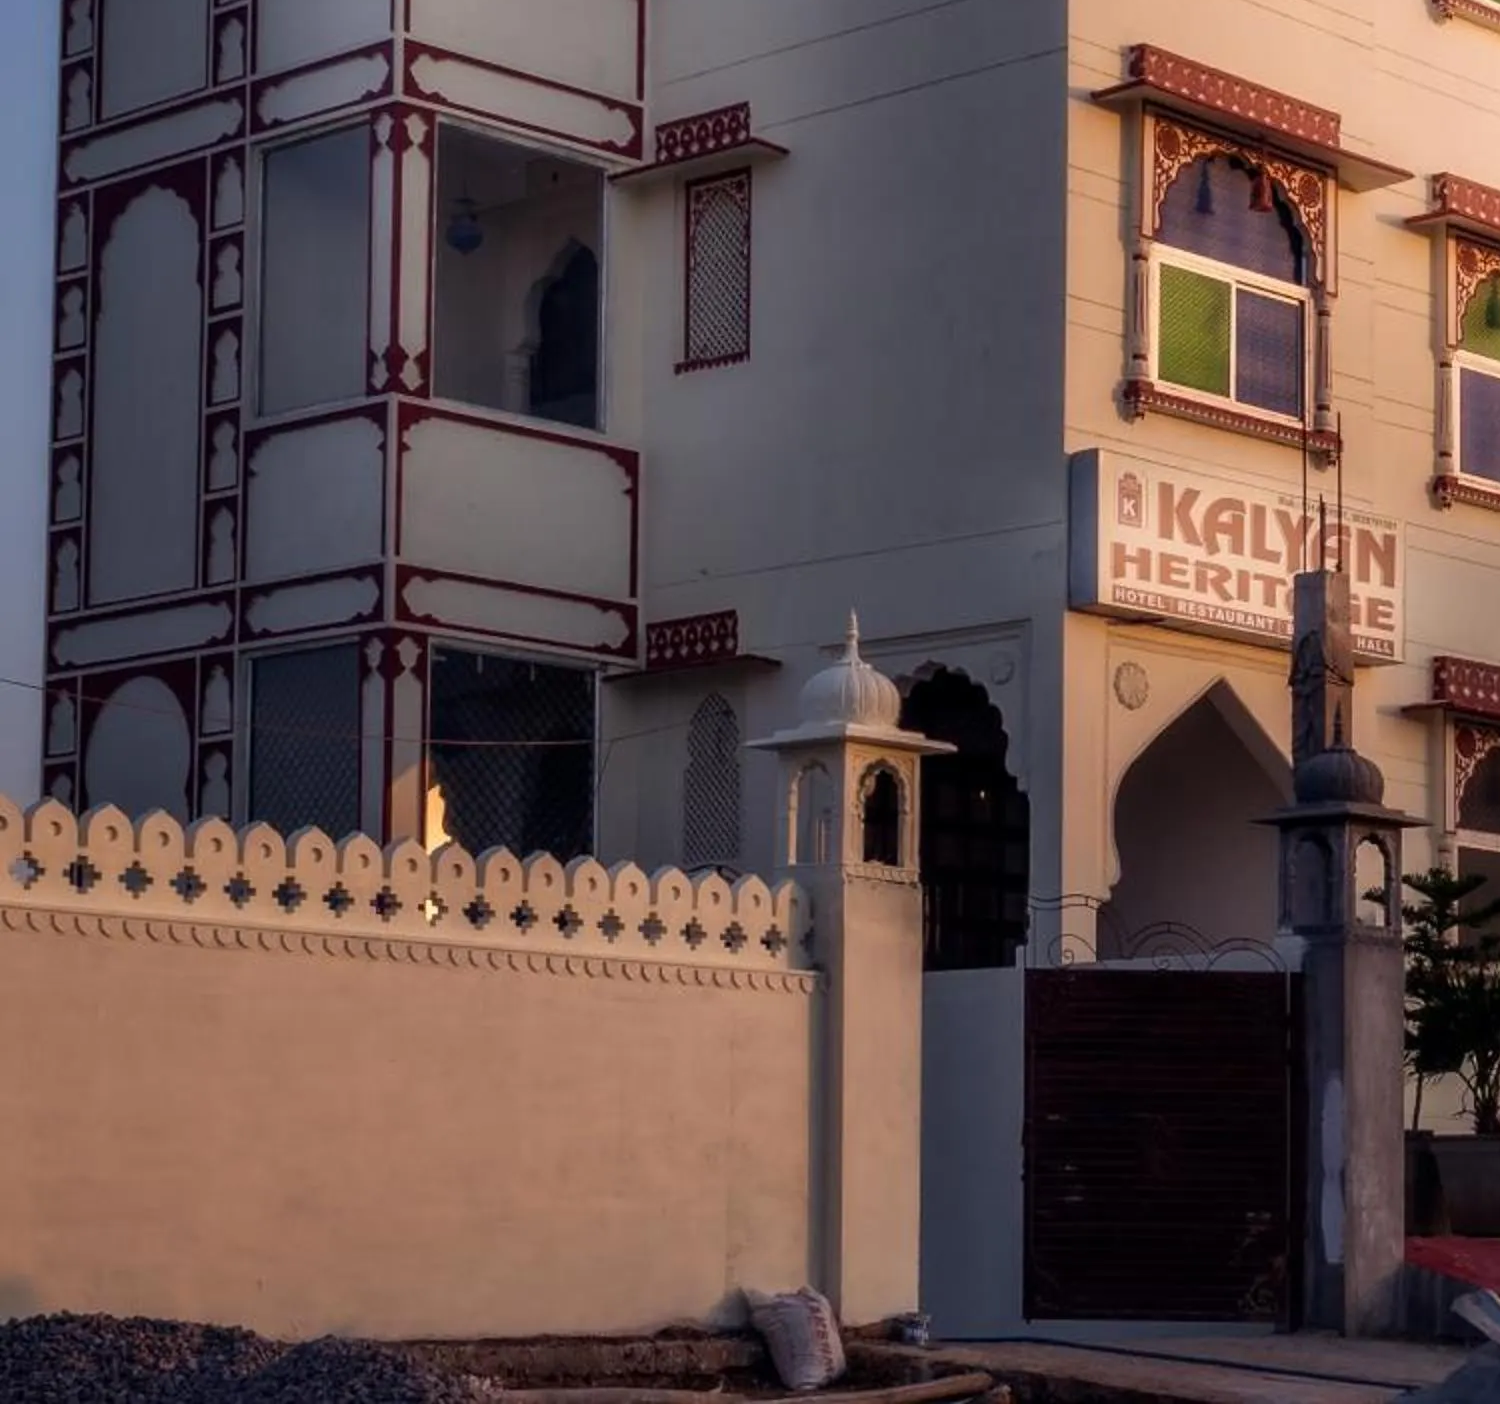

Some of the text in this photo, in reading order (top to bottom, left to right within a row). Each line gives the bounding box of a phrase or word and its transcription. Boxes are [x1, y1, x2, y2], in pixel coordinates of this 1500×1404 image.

[1157, 481, 1397, 588] KALYAN
[1110, 541, 1396, 633] HERITE
[1115, 587, 1166, 609] HOTEL
[1177, 599, 1275, 632] RESTAURANT
[1357, 635, 1393, 654] HALL
